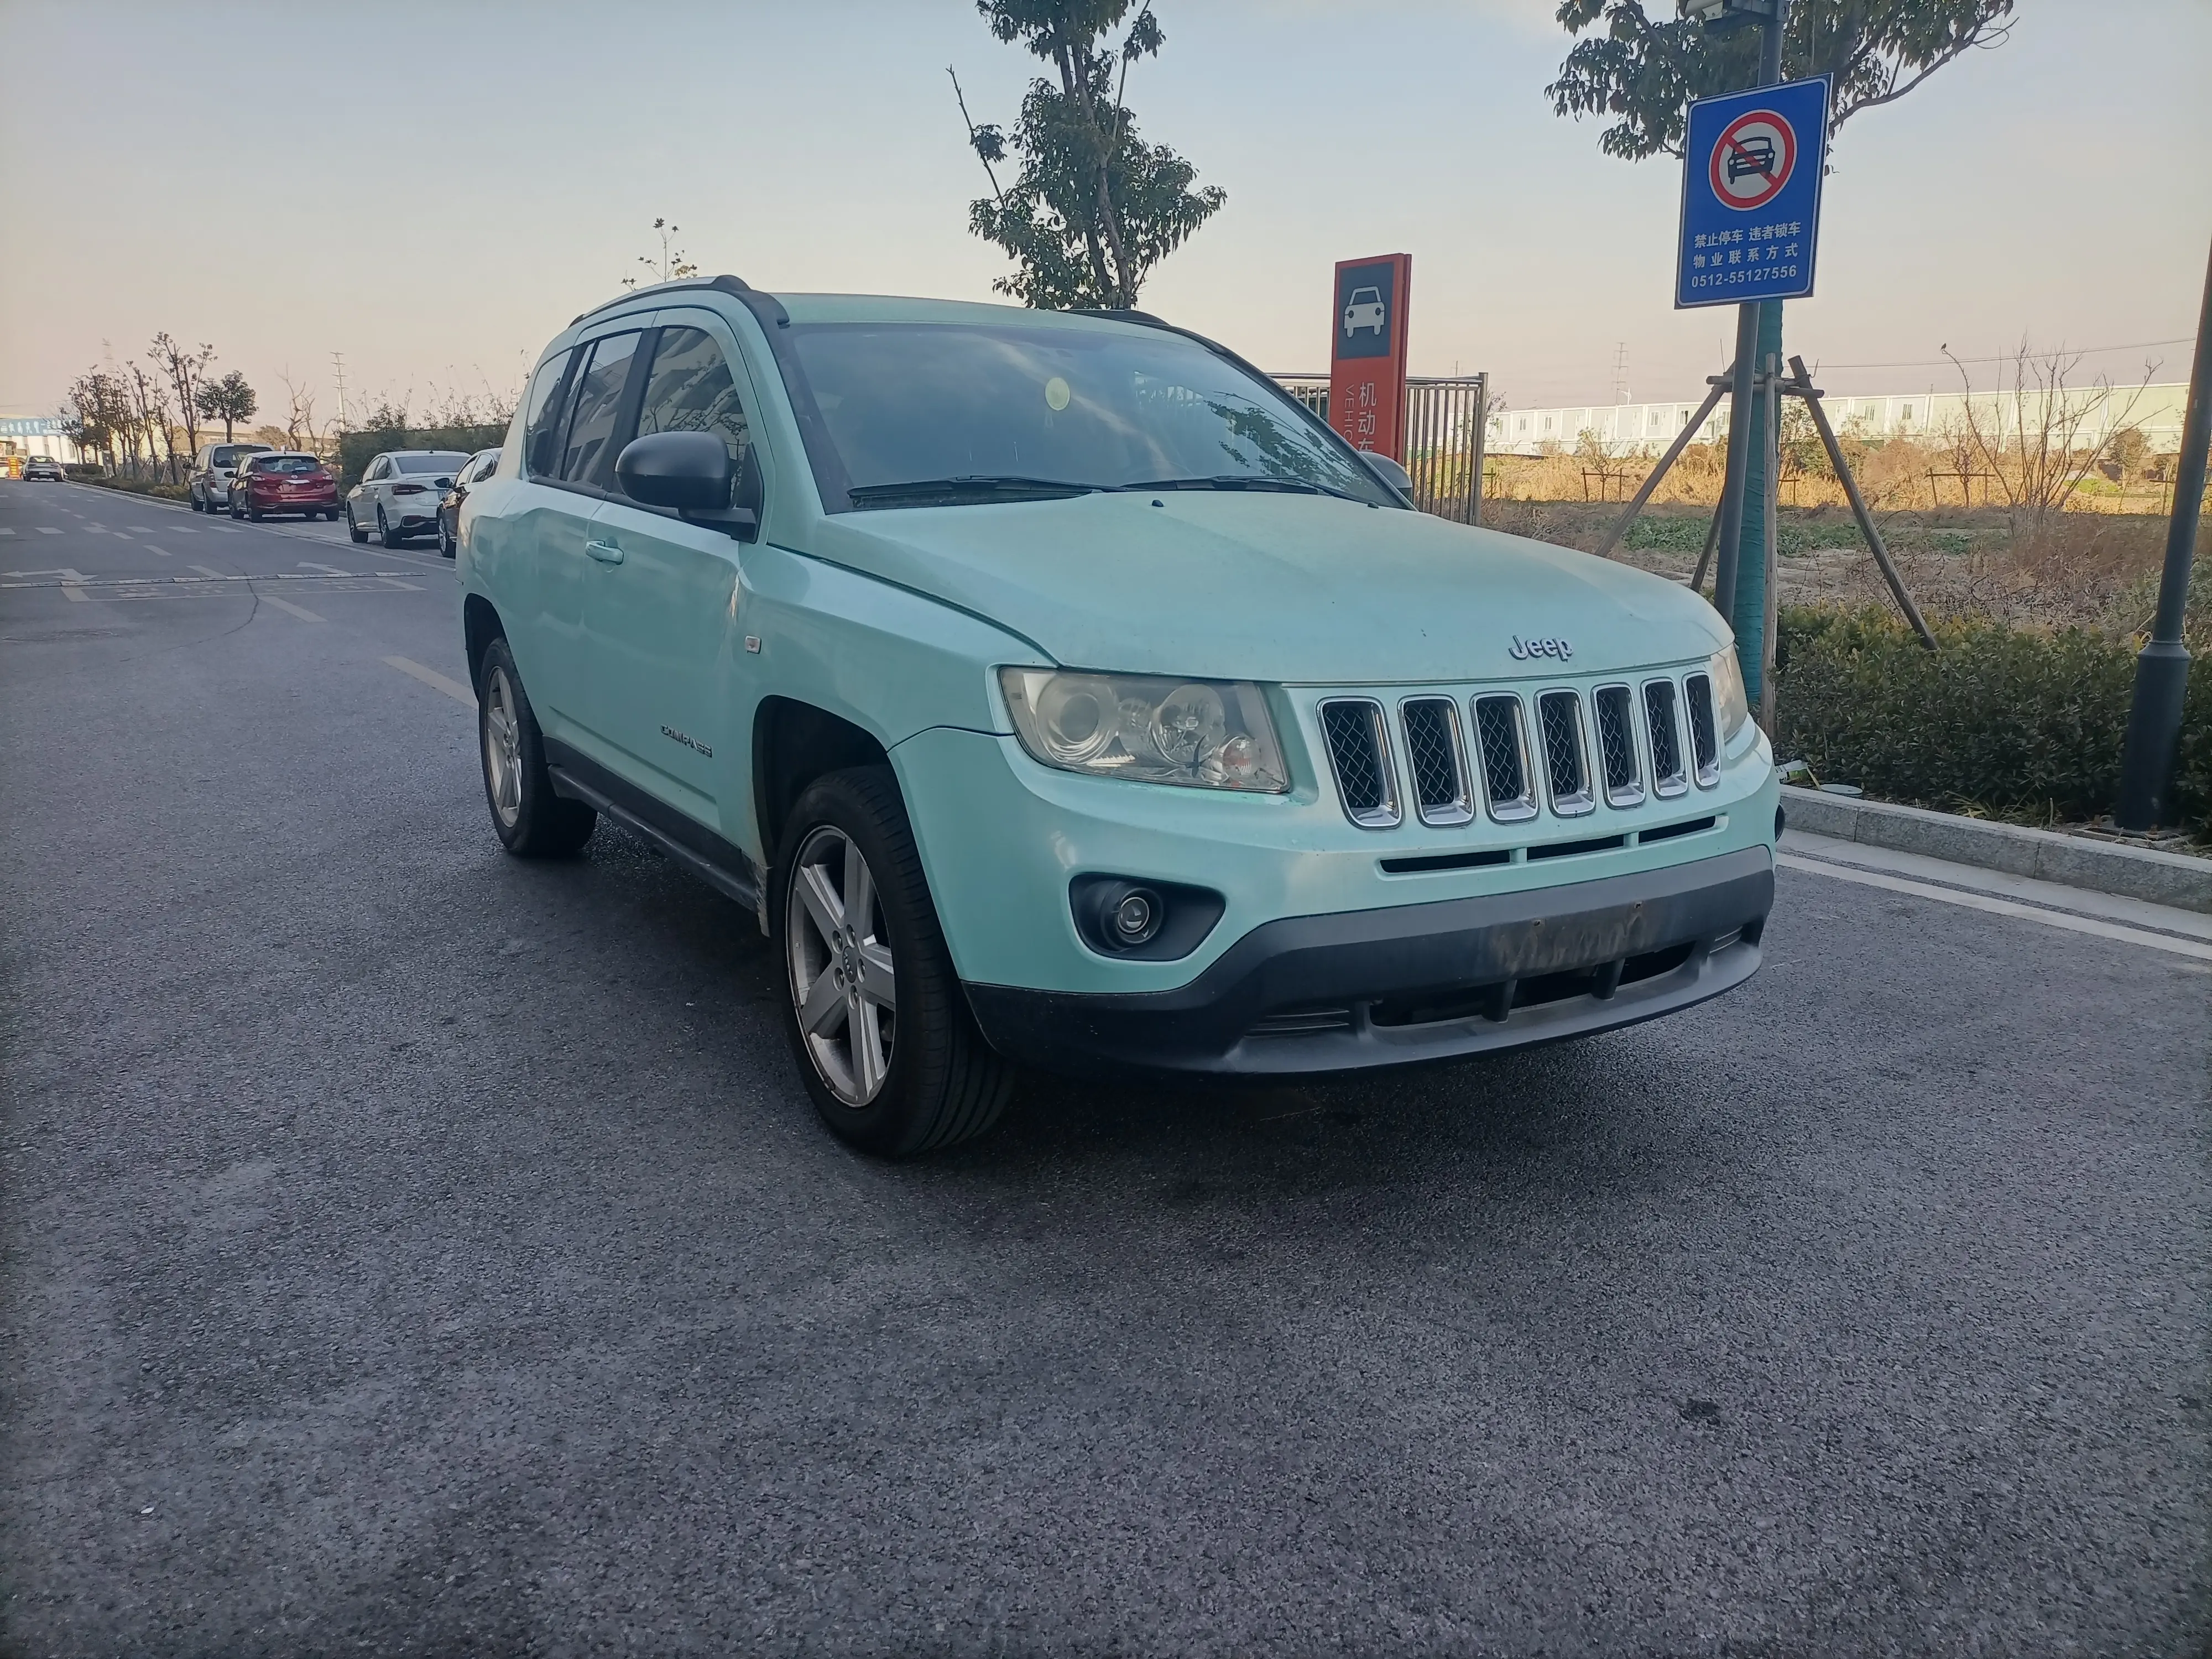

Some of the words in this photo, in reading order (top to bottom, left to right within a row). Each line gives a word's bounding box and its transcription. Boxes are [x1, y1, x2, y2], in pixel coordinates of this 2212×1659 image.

[1694, 229, 1744, 248] 禁止停车
[1748, 221, 1801, 242] 违者锁车
[1693, 242, 1798, 269] 物业联系方式
[1691, 265, 1797, 288] 0512-55127556
[1508, 635, 1574, 662] Jeep
